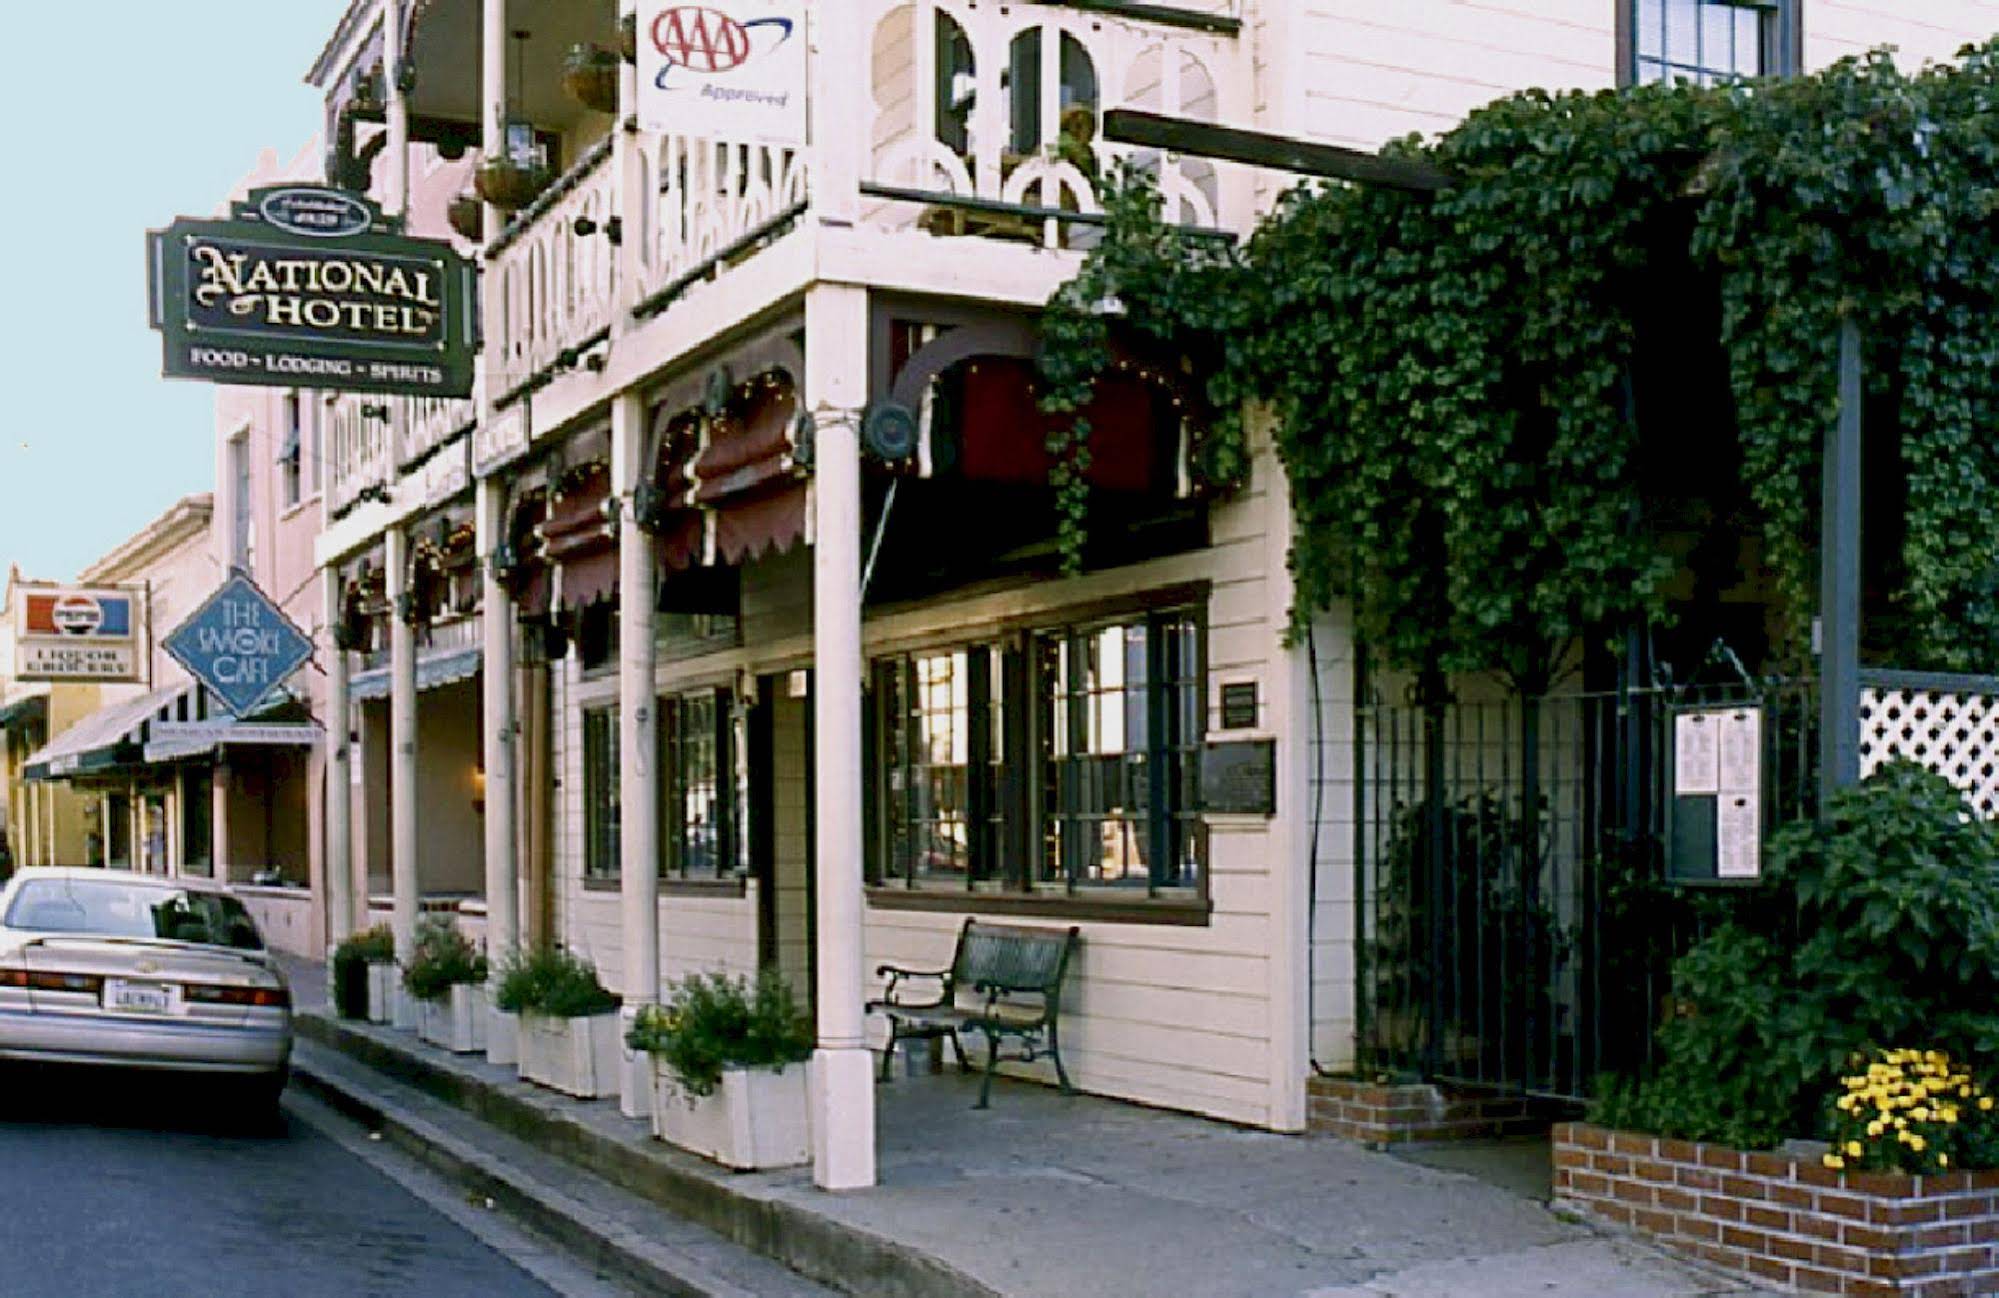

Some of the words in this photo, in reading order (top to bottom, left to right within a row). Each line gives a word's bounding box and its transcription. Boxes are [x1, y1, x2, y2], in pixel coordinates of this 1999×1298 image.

[664, 8, 741, 71] AAA
[701, 83, 789, 108] Approved
[195, 246, 439, 307] NATIONAL
[262, 294, 438, 334] HOTEL
[189, 347, 248, 368] FOOD
[265, 354, 352, 376] LODGING
[370, 362, 444, 384] SPIRITS
[222, 600, 261, 627] THE
